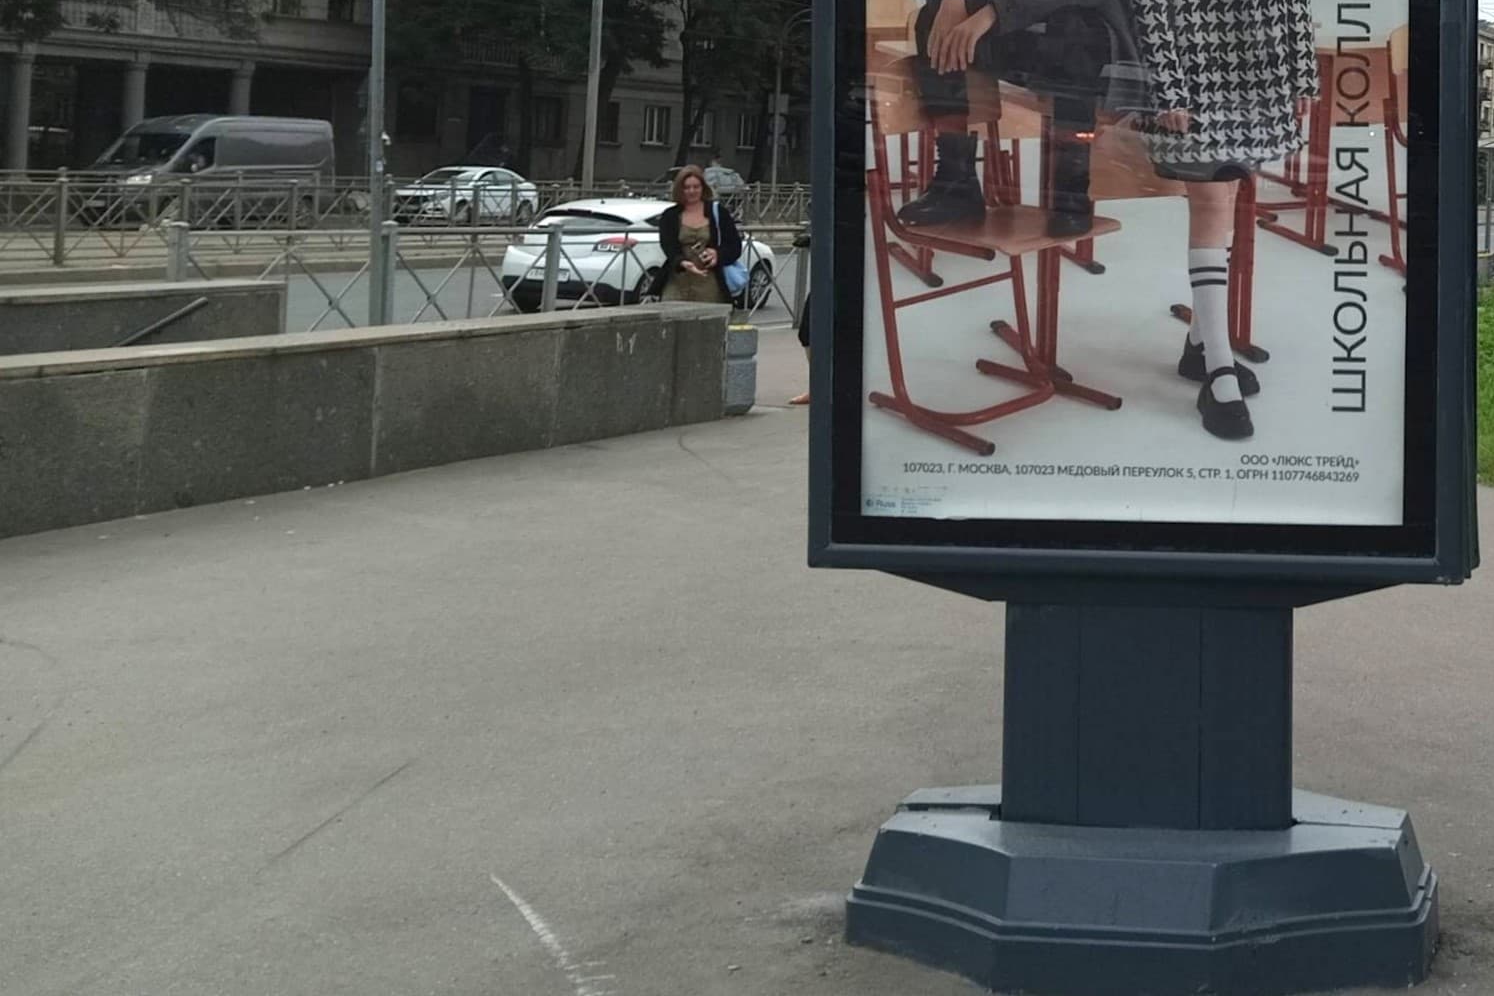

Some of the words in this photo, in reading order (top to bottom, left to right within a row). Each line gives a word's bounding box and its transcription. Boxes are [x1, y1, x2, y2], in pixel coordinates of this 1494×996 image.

[1332, 146, 1370, 413] ШКОЛЬНАЯ
[1240, 454, 1270, 466] ООО
[903, 462, 945, 475] 107023,
[958, 463, 1012, 476] МОСКВА,
[1015, 464, 1055, 476] 107023
[1057, 464, 1120, 478] МЕДОВЫЙ
[1122, 466, 1184, 479] ПЕРЕУЛОК
[1198, 467, 1222, 479] СТР.
[1236, 469, 1269, 480] ОГРН
